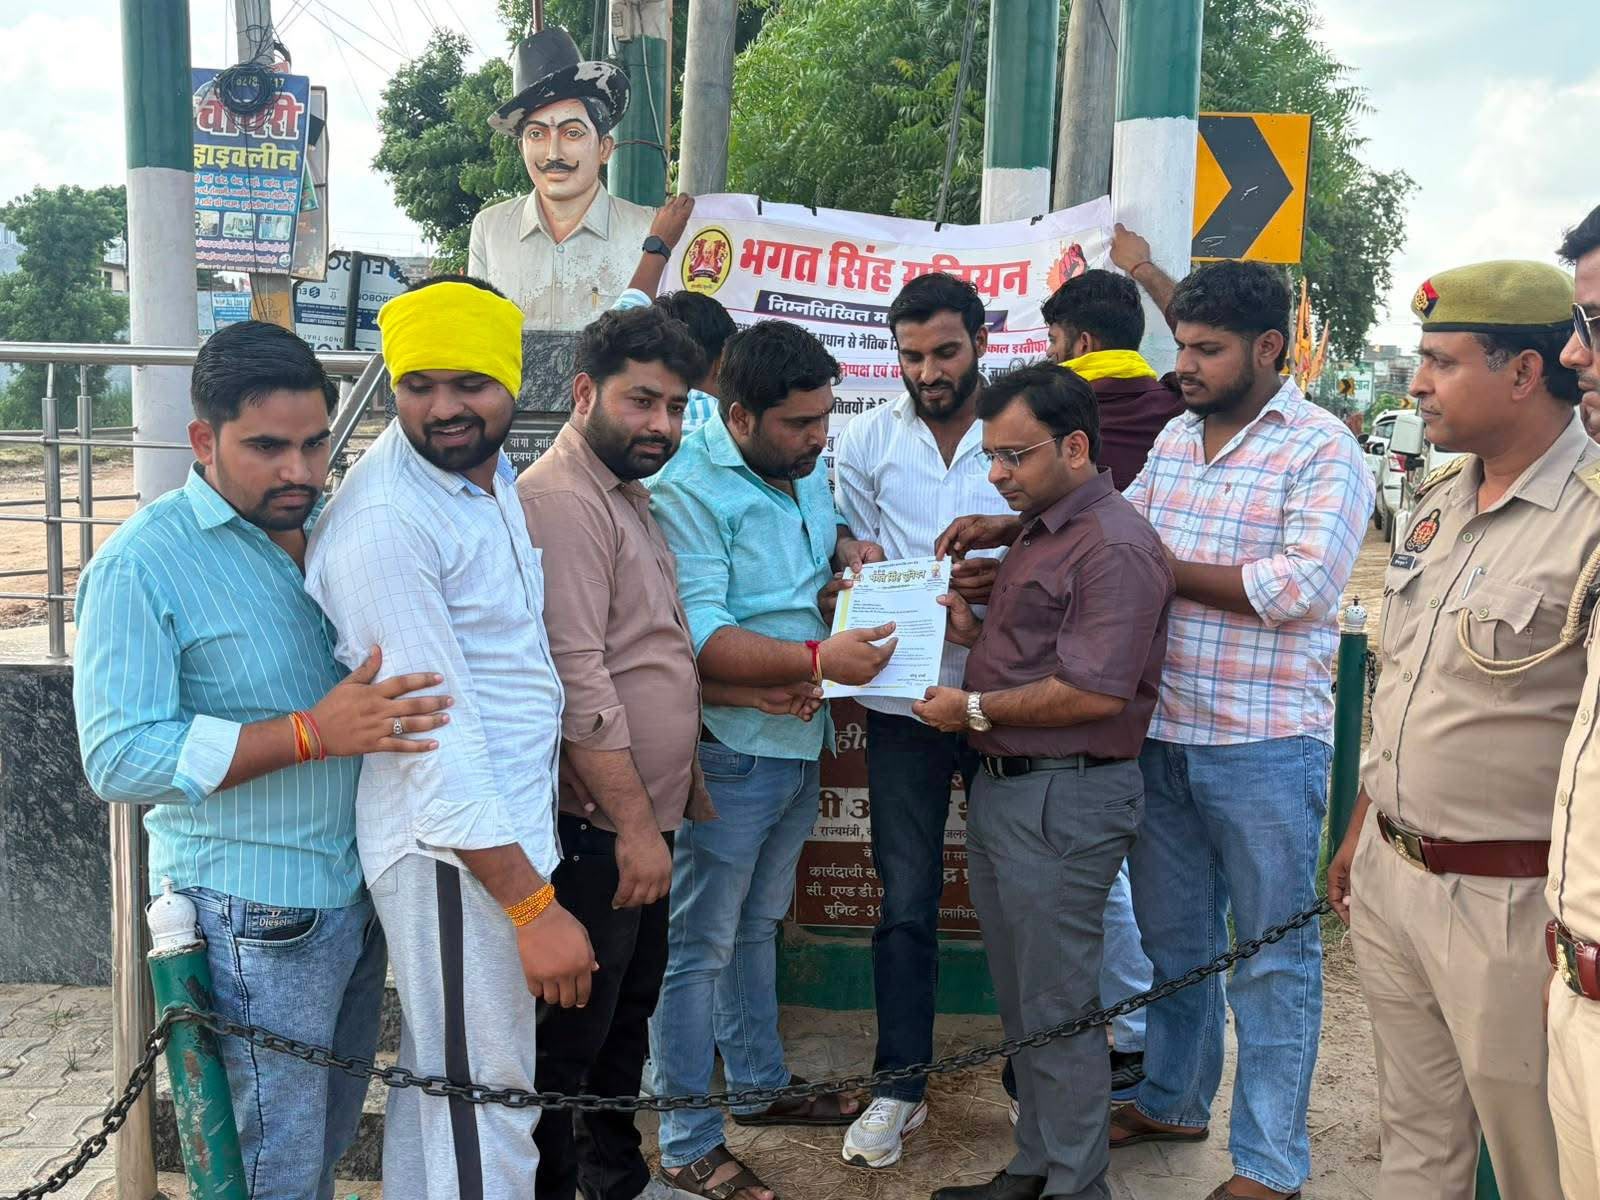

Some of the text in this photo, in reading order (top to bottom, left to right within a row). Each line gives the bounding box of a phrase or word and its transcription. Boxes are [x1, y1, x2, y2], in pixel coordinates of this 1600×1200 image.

[739, 238, 823, 285] भगत
[828, 240, 896, 293] सिंह
[768, 294, 870, 322] निम्नलिखित
[848, 332, 858, 348] से
[858, 334, 889, 350] नैतिक
[873, 362, 891, 378] एवं
[808, 863, 864, 879] कार्यदायी
[805, 881, 826, 897] सी.
[829, 886, 857, 900] एण्ड
